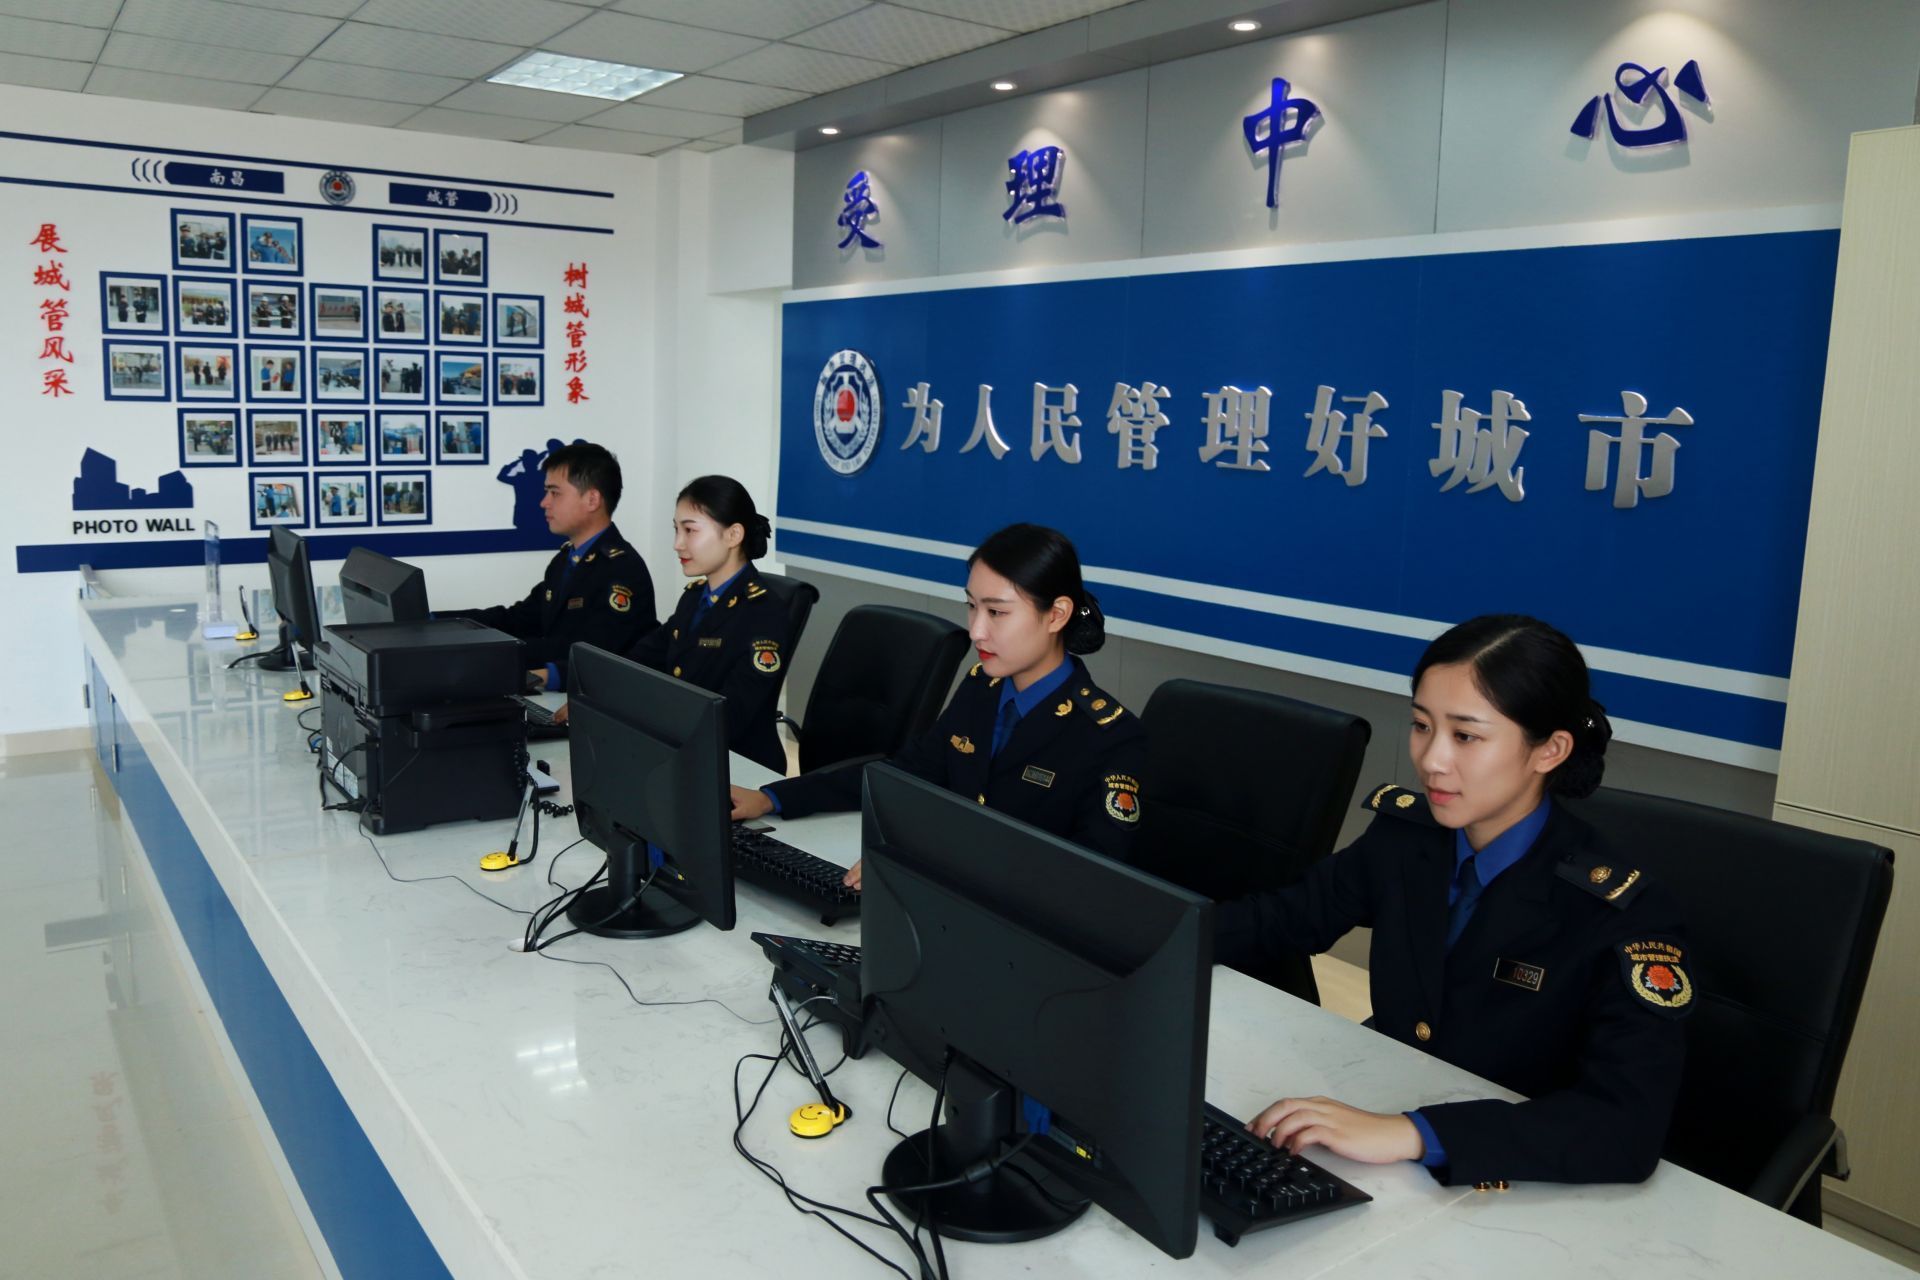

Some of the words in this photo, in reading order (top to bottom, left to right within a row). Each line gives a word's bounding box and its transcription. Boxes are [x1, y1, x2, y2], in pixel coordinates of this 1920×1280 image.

[209, 168, 245, 187] 南昌
[426, 189, 459, 207] 城管
[837, 60, 1711, 250] 受理中心
[31, 224, 75, 397] 展城管风采
[564, 262, 590, 404] 树城管形象
[902, 381, 1696, 508] 为人民管理好城市
[73, 519, 138, 534] PHOTO
[145, 518, 195, 532] WALL
